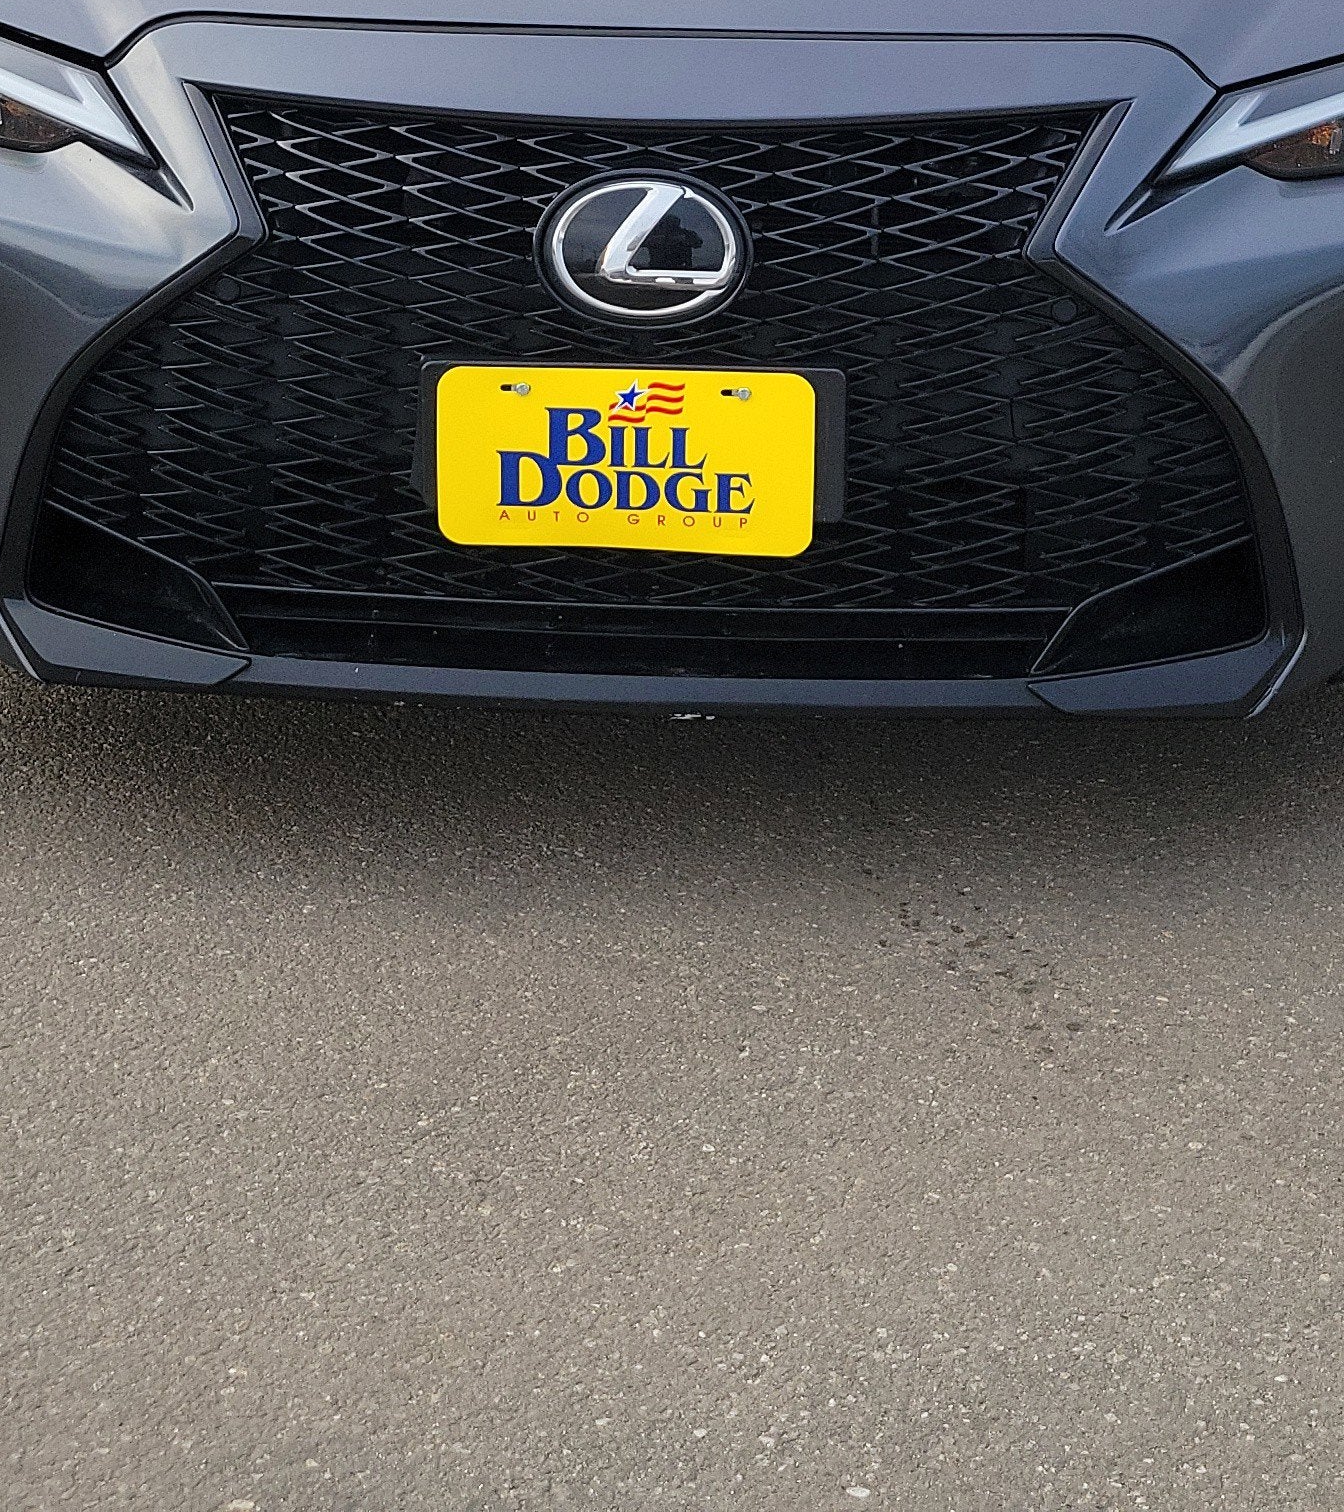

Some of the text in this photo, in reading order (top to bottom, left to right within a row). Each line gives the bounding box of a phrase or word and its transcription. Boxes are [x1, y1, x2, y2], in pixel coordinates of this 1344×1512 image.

[544, 406, 708, 470] BILL
[495, 449, 756, 515] DODGE
[498, 509, 749, 529] AUTO GROUP
